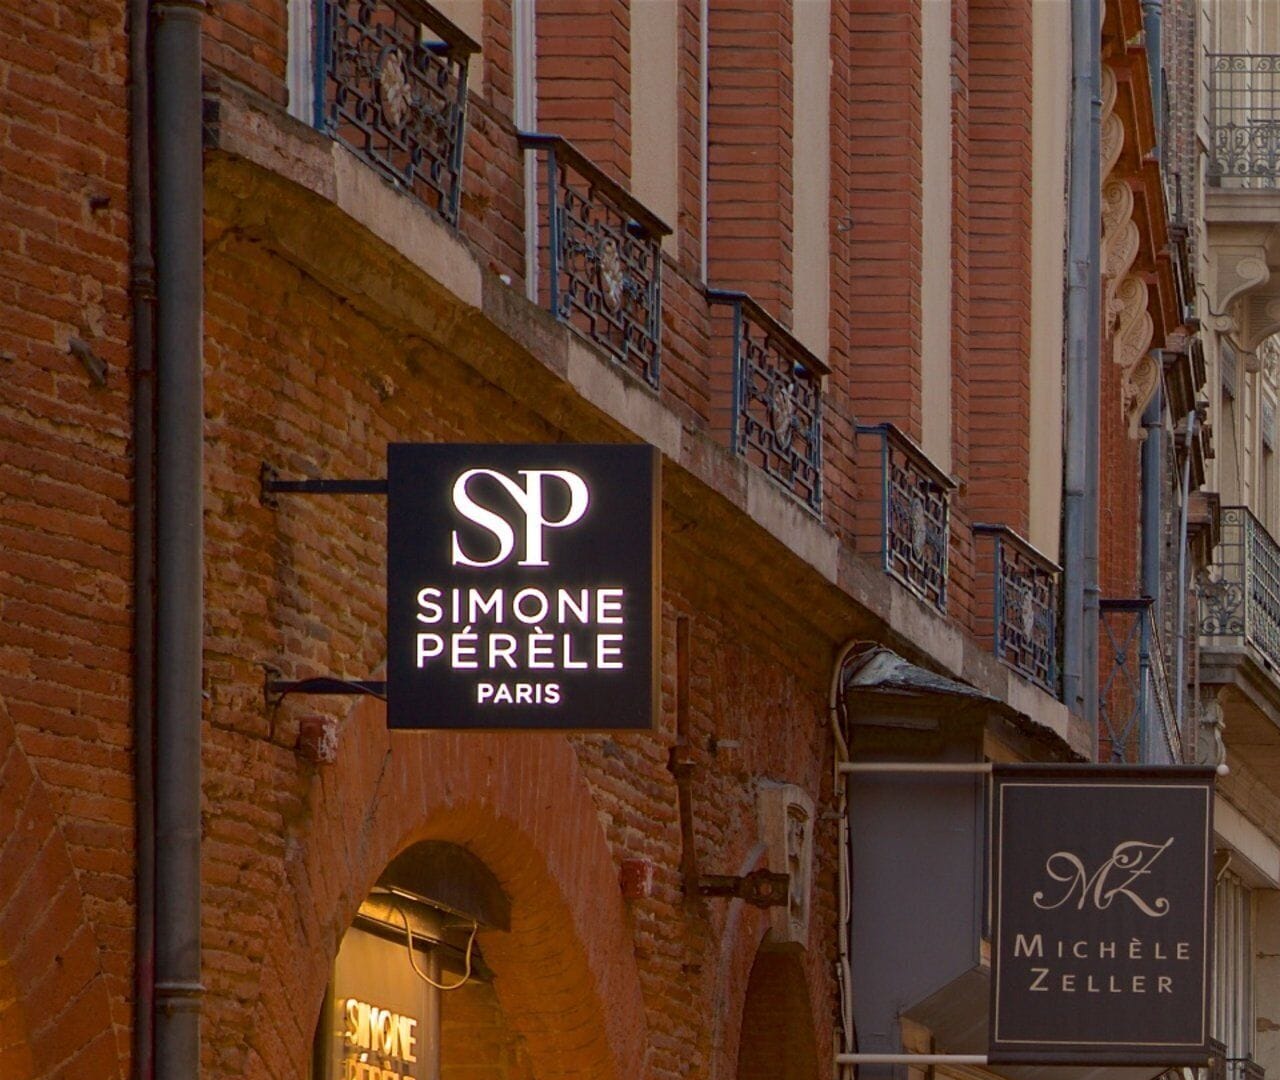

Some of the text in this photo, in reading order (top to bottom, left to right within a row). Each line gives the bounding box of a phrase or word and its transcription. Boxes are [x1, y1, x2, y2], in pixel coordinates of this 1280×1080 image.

[416, 587, 625, 625] SIMONE
[416, 626, 625, 670] PÉRÈLE
[476, 682, 562, 705] PARIS
